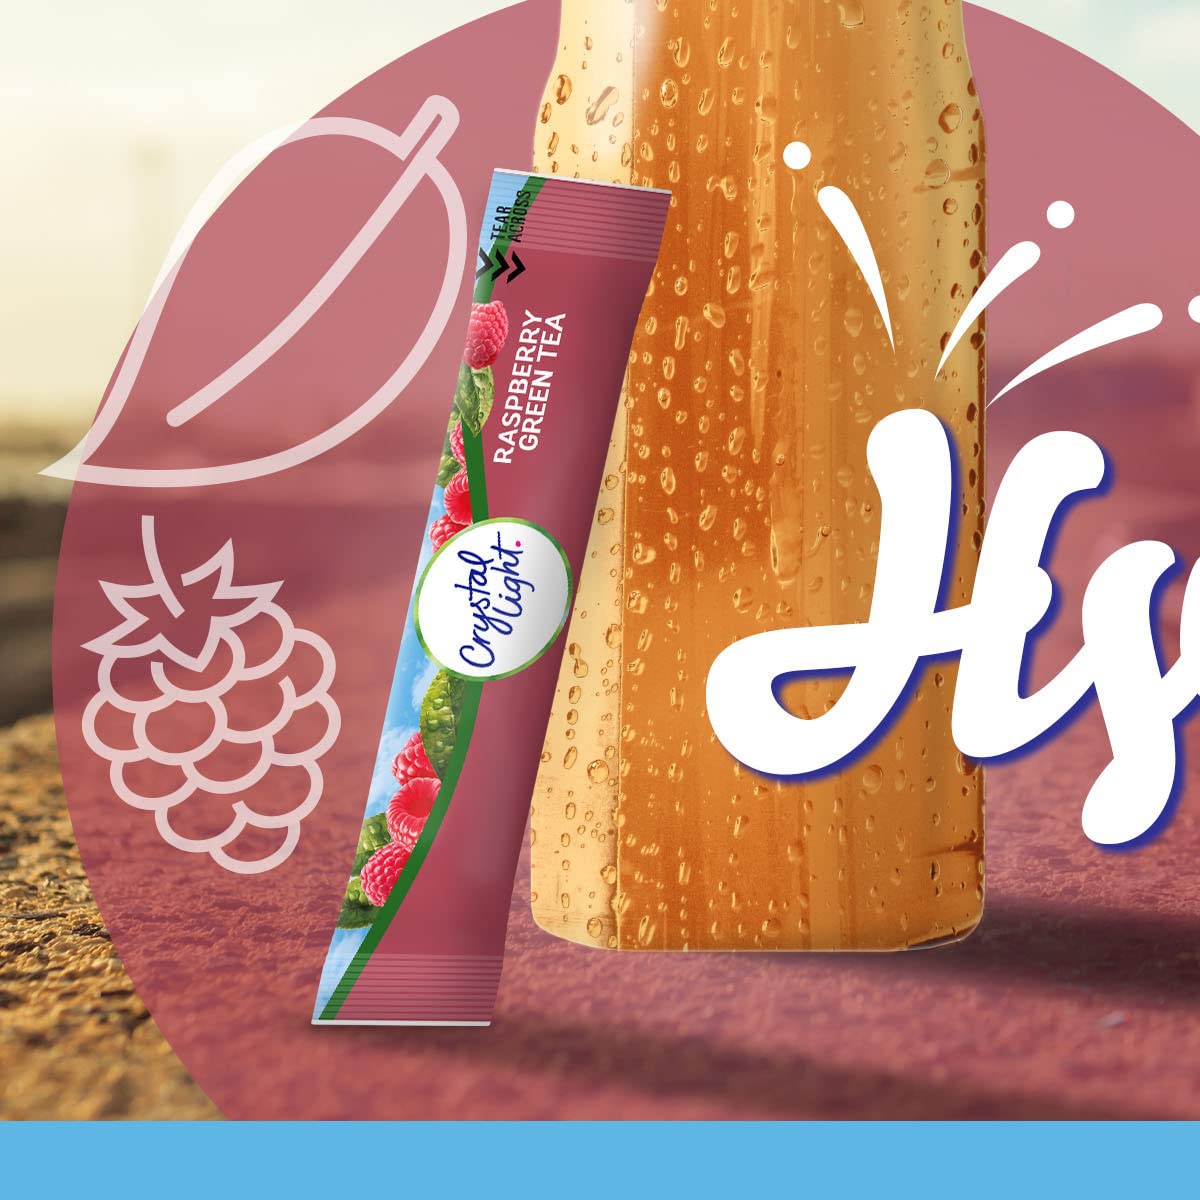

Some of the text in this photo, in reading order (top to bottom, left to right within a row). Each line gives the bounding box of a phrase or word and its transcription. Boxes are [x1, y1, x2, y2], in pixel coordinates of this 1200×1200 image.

[490, 205, 512, 240] TEAR
[507, 190, 531, 243] ACROSS
[493, 309, 543, 464] RASPBERRY
[519, 313, 566, 451] GREEN TEA
[454, 550, 513, 669] Crystal
